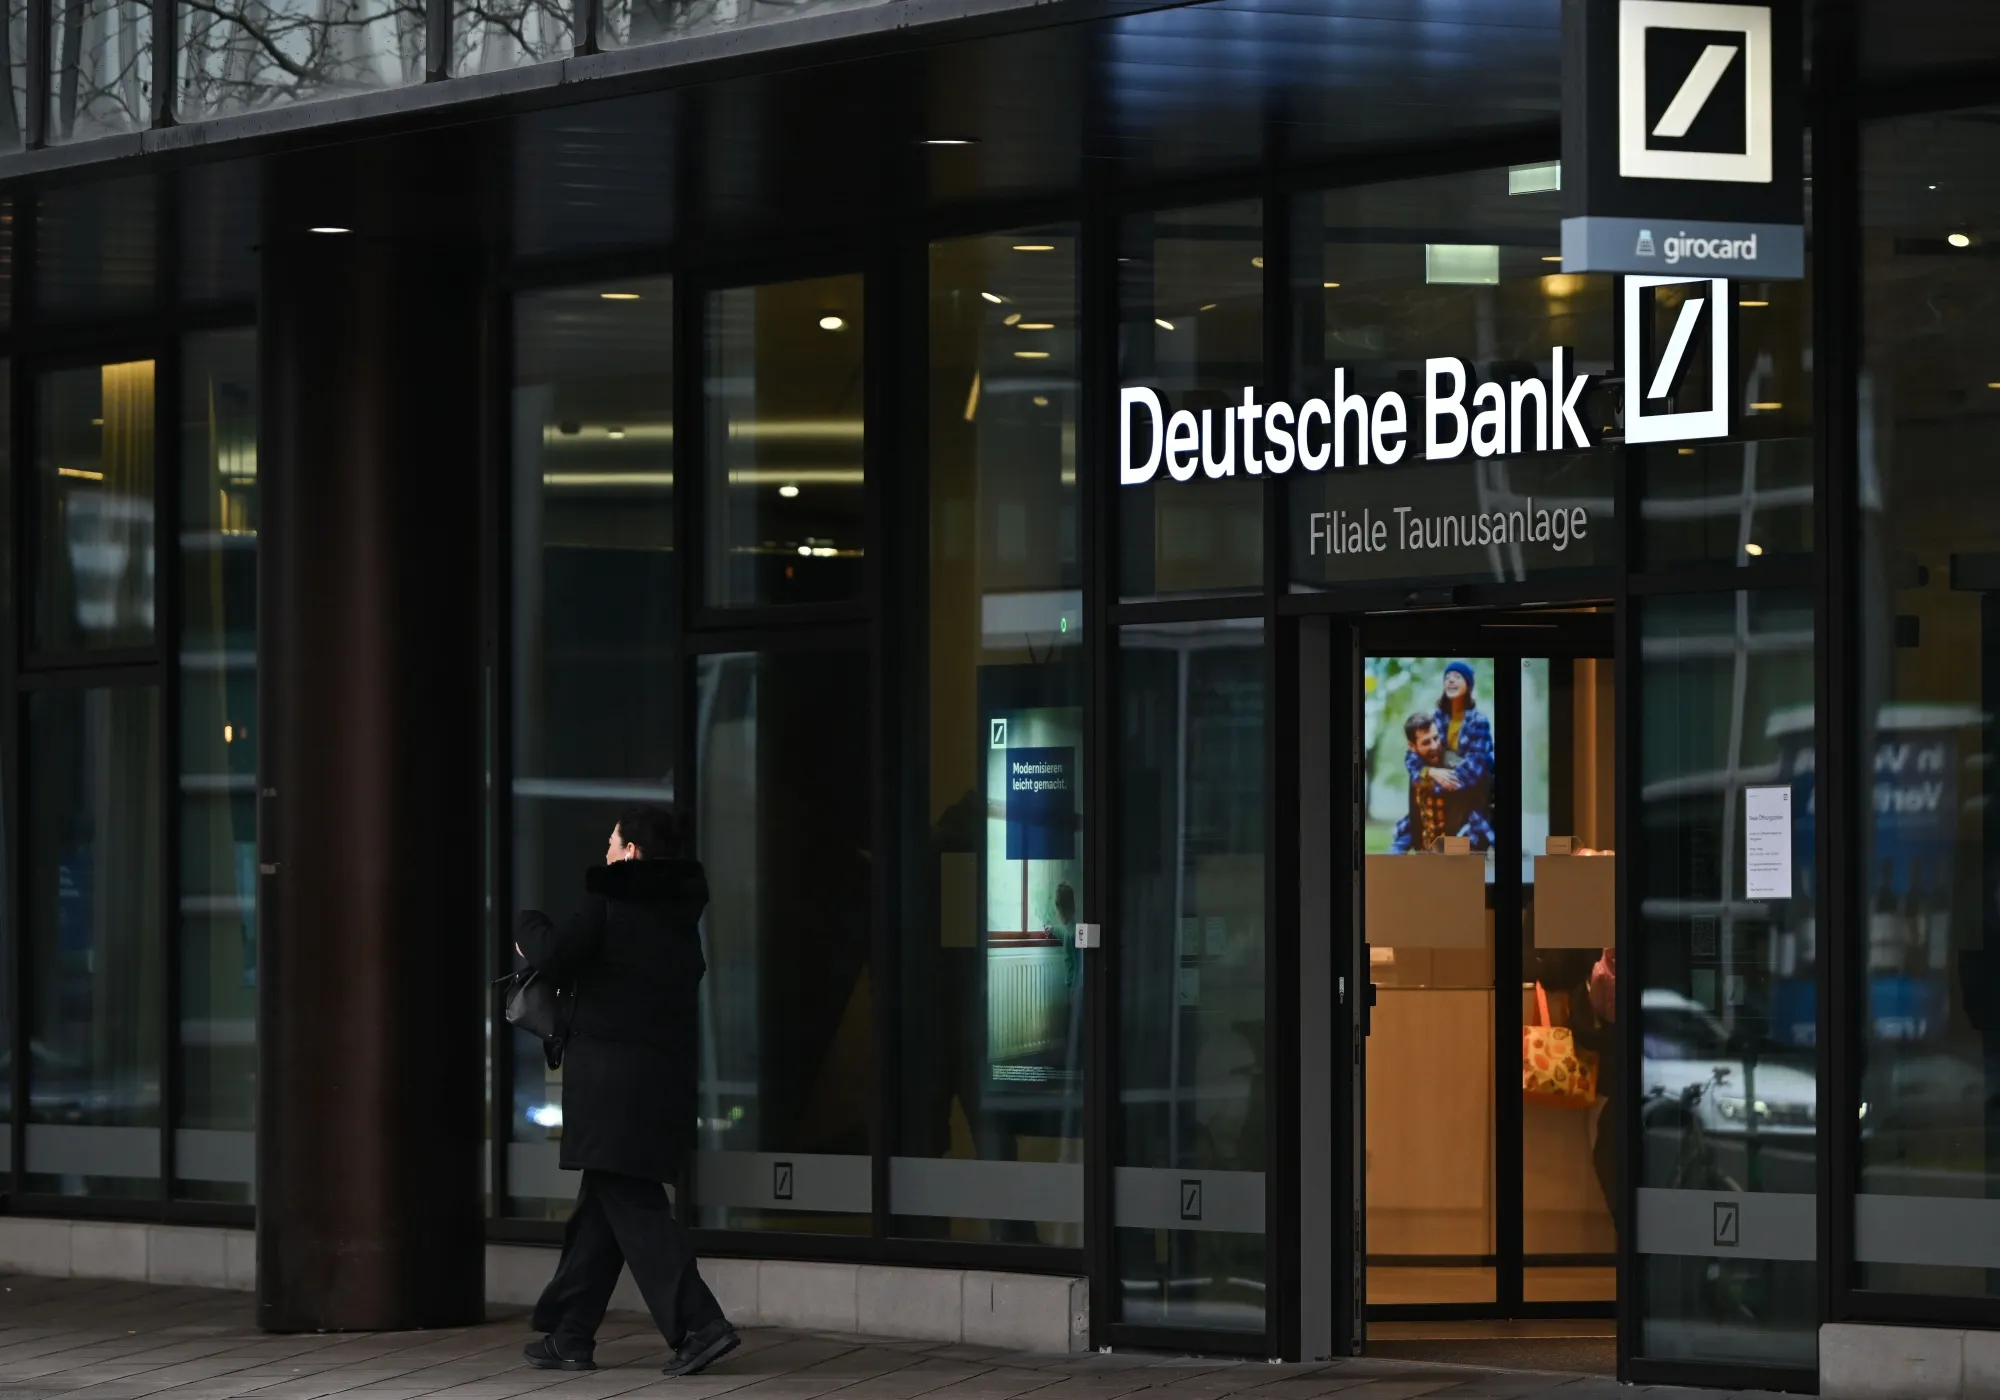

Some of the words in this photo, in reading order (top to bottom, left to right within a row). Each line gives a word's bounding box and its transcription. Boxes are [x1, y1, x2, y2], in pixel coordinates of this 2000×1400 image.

[1664, 231, 1757, 264] girocard
[1121, 367, 1407, 485] Deutsche
[1425, 345, 1590, 461] Bank
[1309, 508, 1387, 556] Filiale
[1393, 497, 1587, 552] Taunusanlage
[1012, 761, 1063, 774] Modernisieren
[1012, 778, 1033, 790] leicht
[1034, 778, 1067, 793] gemacht.
